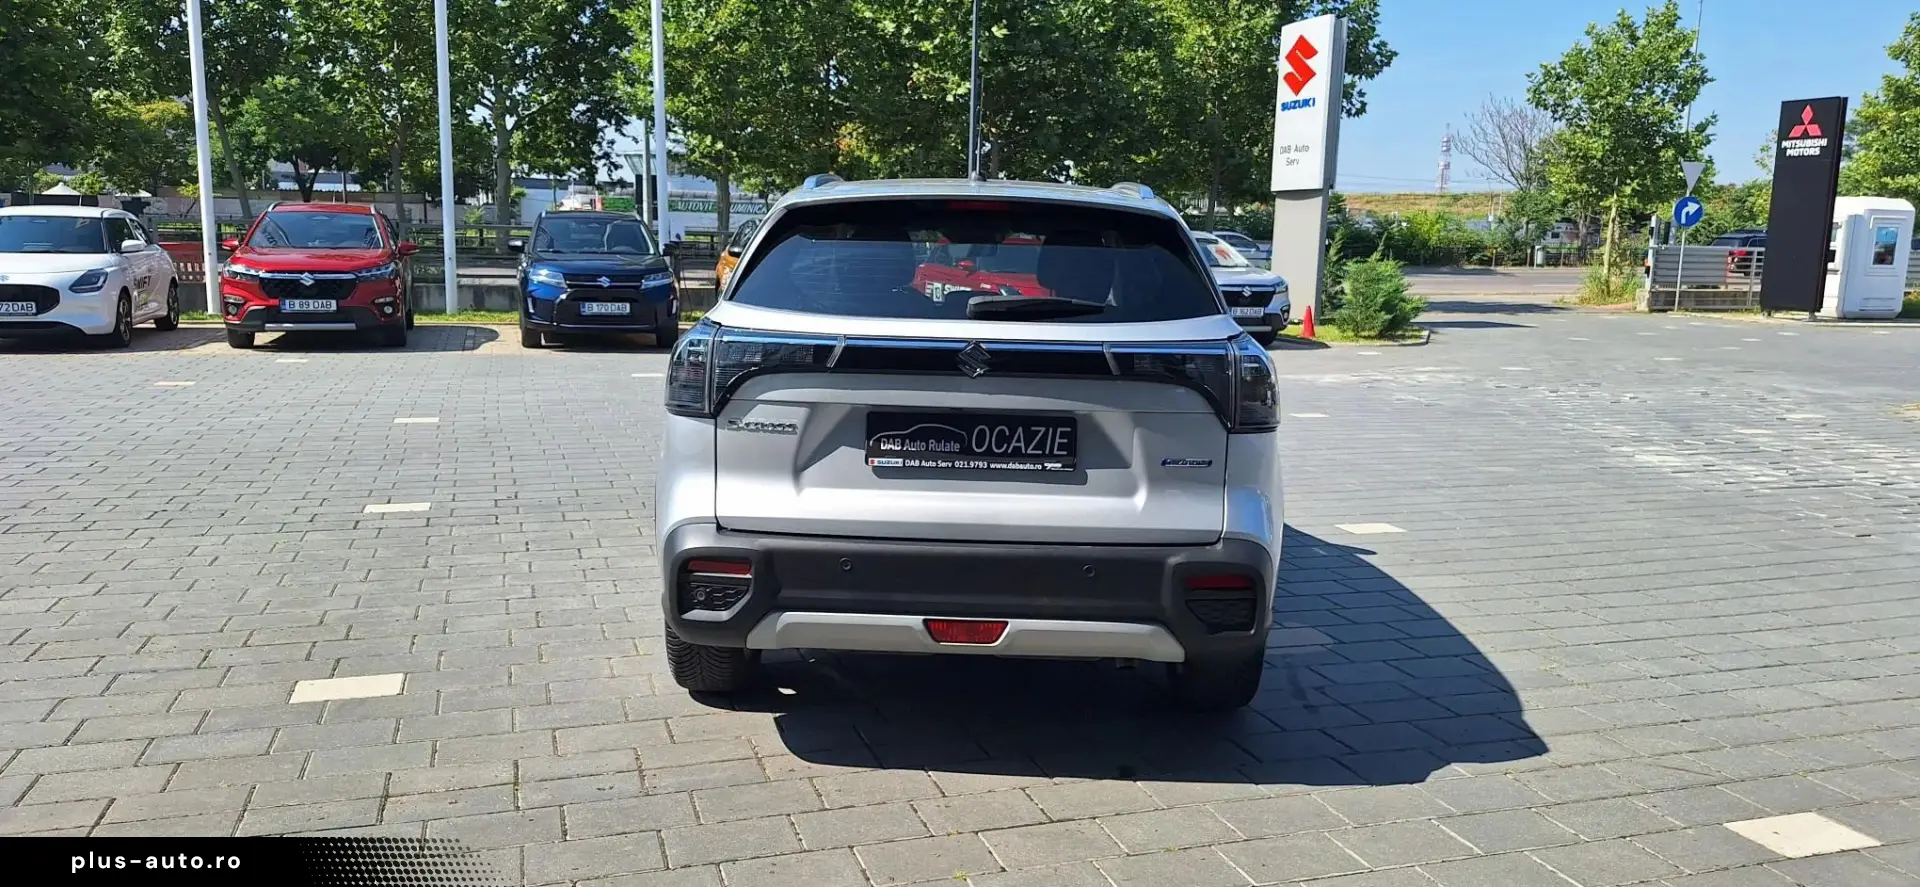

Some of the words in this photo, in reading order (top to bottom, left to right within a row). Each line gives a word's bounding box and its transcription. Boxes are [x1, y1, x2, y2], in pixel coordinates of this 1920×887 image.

[1281, 98, 1316, 112] SUZUKI
[1781, 138, 1828, 148] MITSUBISHI
[1280, 145, 1292, 155] DAB
[1294, 144, 1310, 153] Auto
[1785, 147, 1821, 157] MOTORS
[1285, 157, 1300, 167] Serv
[729, 203, 767, 214] UMINICA
[312, 300, 332, 309] DAB
[880, 438, 902, 450] DAB
[903, 439, 926, 451] Auto
[928, 439, 961, 452] Rulate
[971, 425, 1072, 454] OCAZIE
[937, 460, 953, 468] Serv
[954, 460, 988, 469] 021.9793
[989, 462, 1043, 471] www.dabauto.ro
